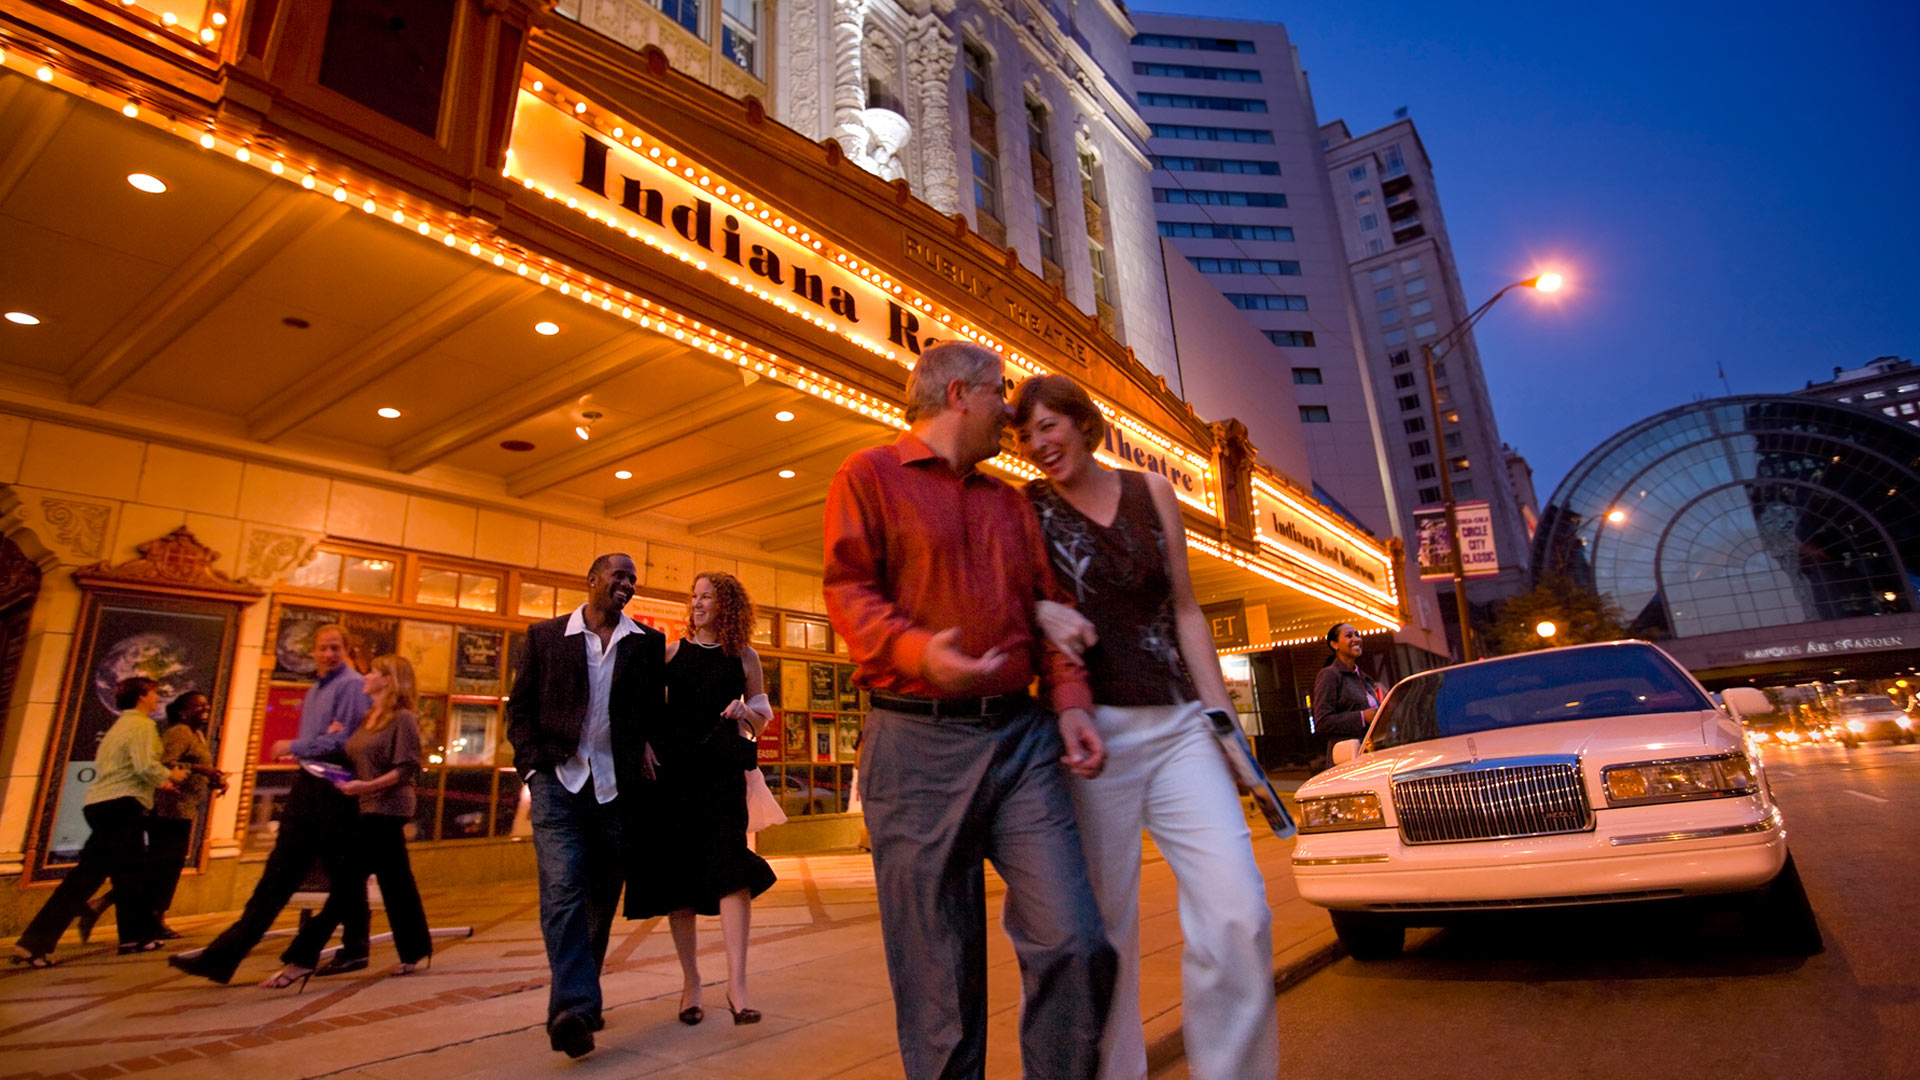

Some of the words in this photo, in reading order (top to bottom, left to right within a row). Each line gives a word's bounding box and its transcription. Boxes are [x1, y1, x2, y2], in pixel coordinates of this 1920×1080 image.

[575, 132, 860, 324] Indiana
[905, 234, 994, 304] PUBLIX
[1005, 297, 1088, 364] THEATRE
[1103, 421, 1194, 493] Theatre
[1462, 524, 1488, 538] CIRCLE
[1468, 539, 1486, 551] CITY
[1462, 551, 1496, 564] CLASSIC
[1212, 615, 1236, 638] ET
